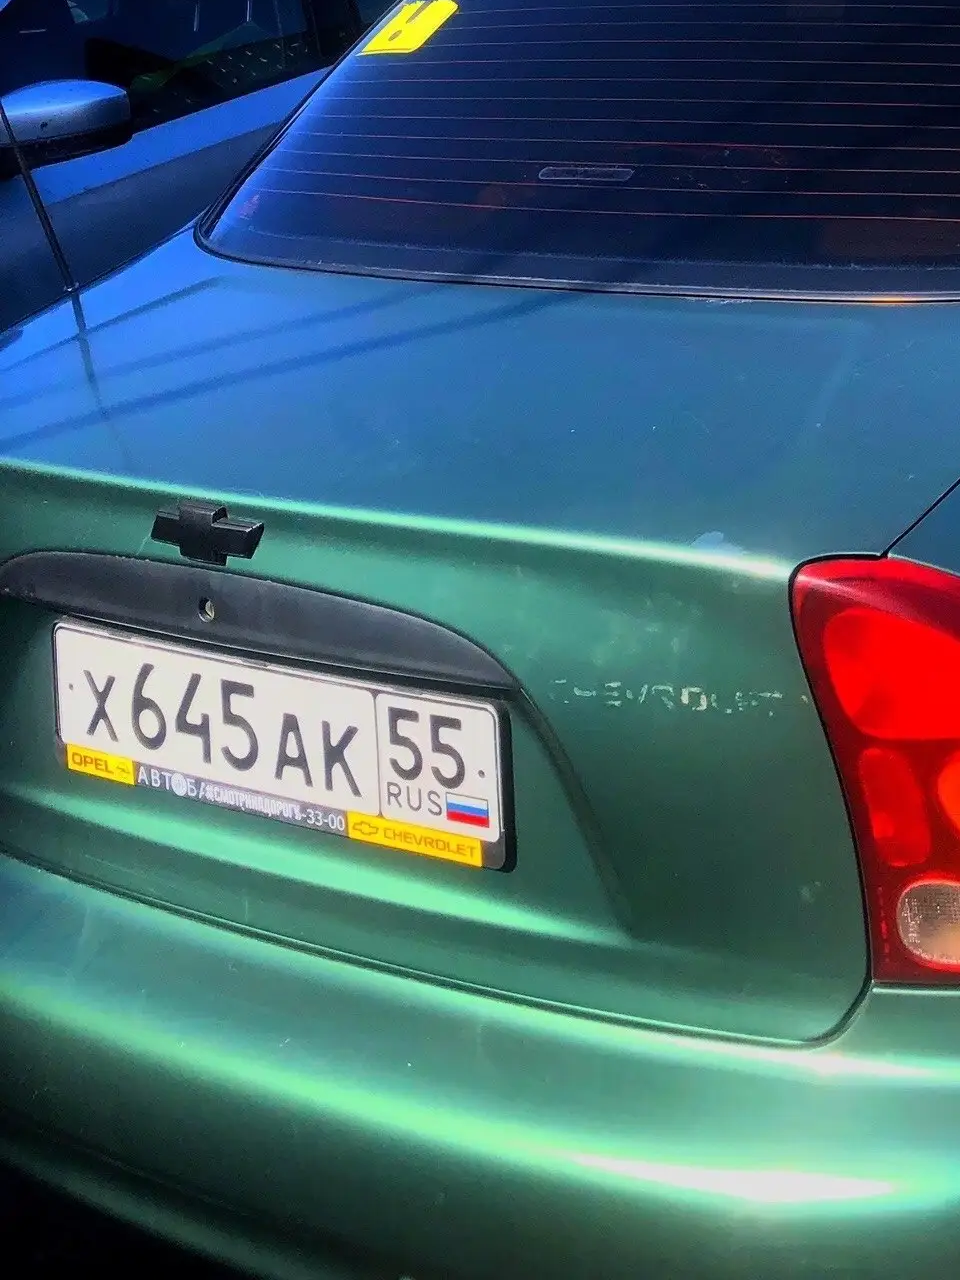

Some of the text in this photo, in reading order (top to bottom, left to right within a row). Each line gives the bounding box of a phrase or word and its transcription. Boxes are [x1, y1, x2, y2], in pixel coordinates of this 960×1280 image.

[71, 751, 115, 775] OPEL
[387, 705, 466, 789] 55
[386, 781, 443, 817] RUS
[383, 826, 477, 859] CHEVROLET
